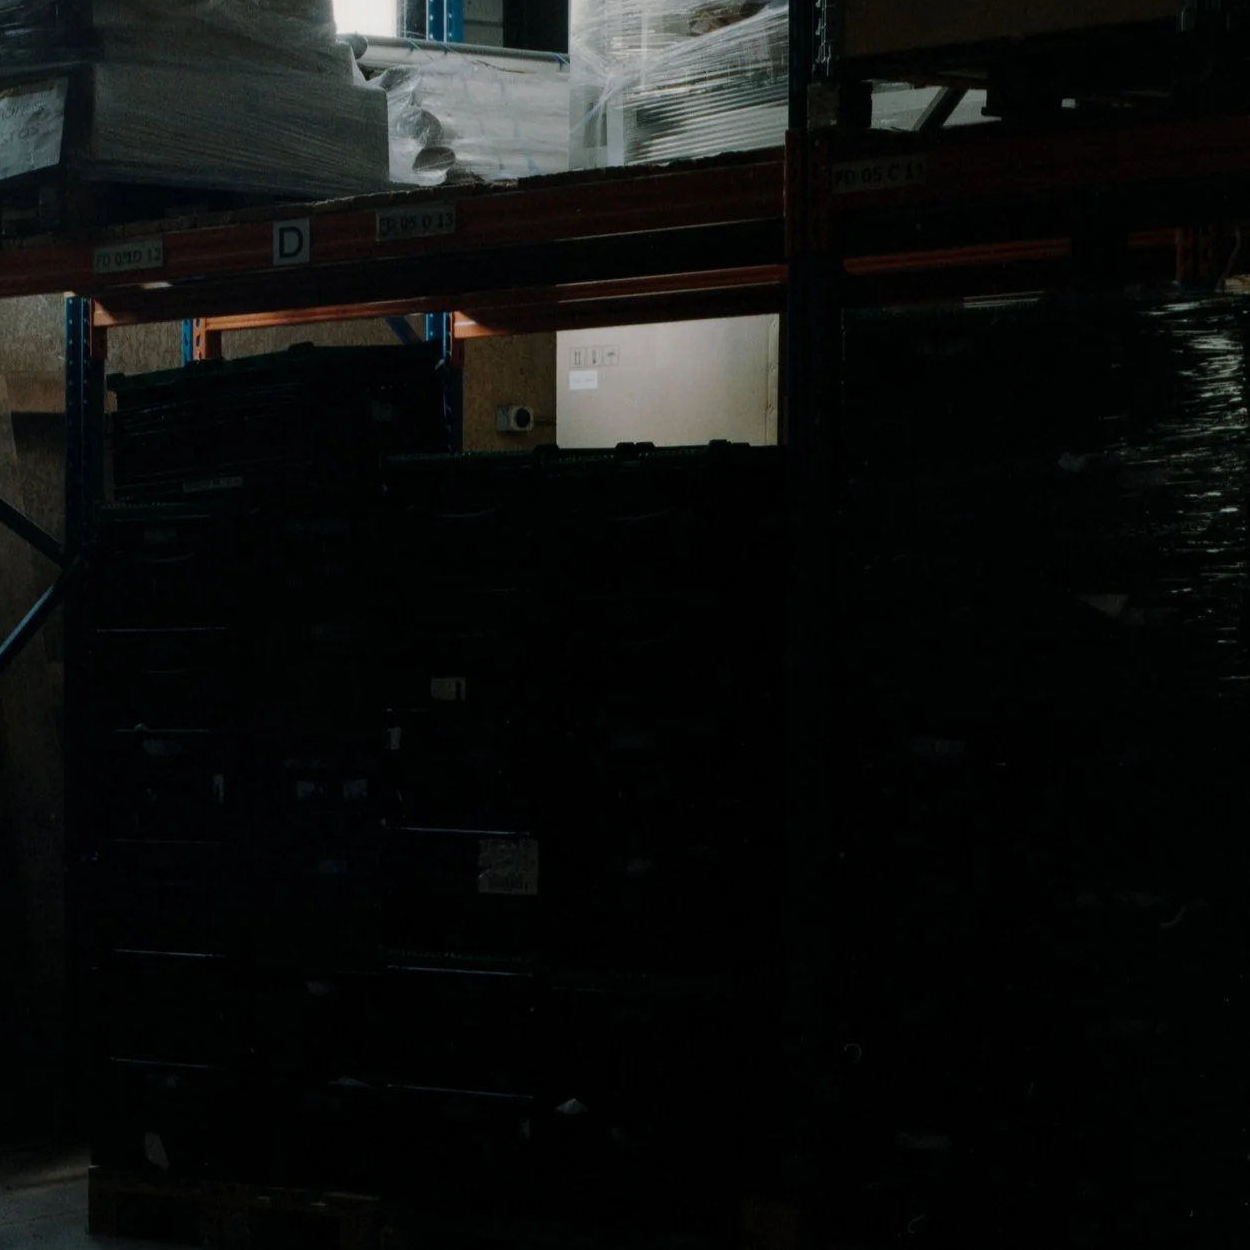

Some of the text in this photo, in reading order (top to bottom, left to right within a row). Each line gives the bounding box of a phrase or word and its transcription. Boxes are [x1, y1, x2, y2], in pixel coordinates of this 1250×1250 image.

[861, 166, 882, 183] 05
[888, 164, 899, 181] C
[438, 212, 454, 228] 13
[279, 226, 303, 258] D
[97, 253, 111, 268] FD
